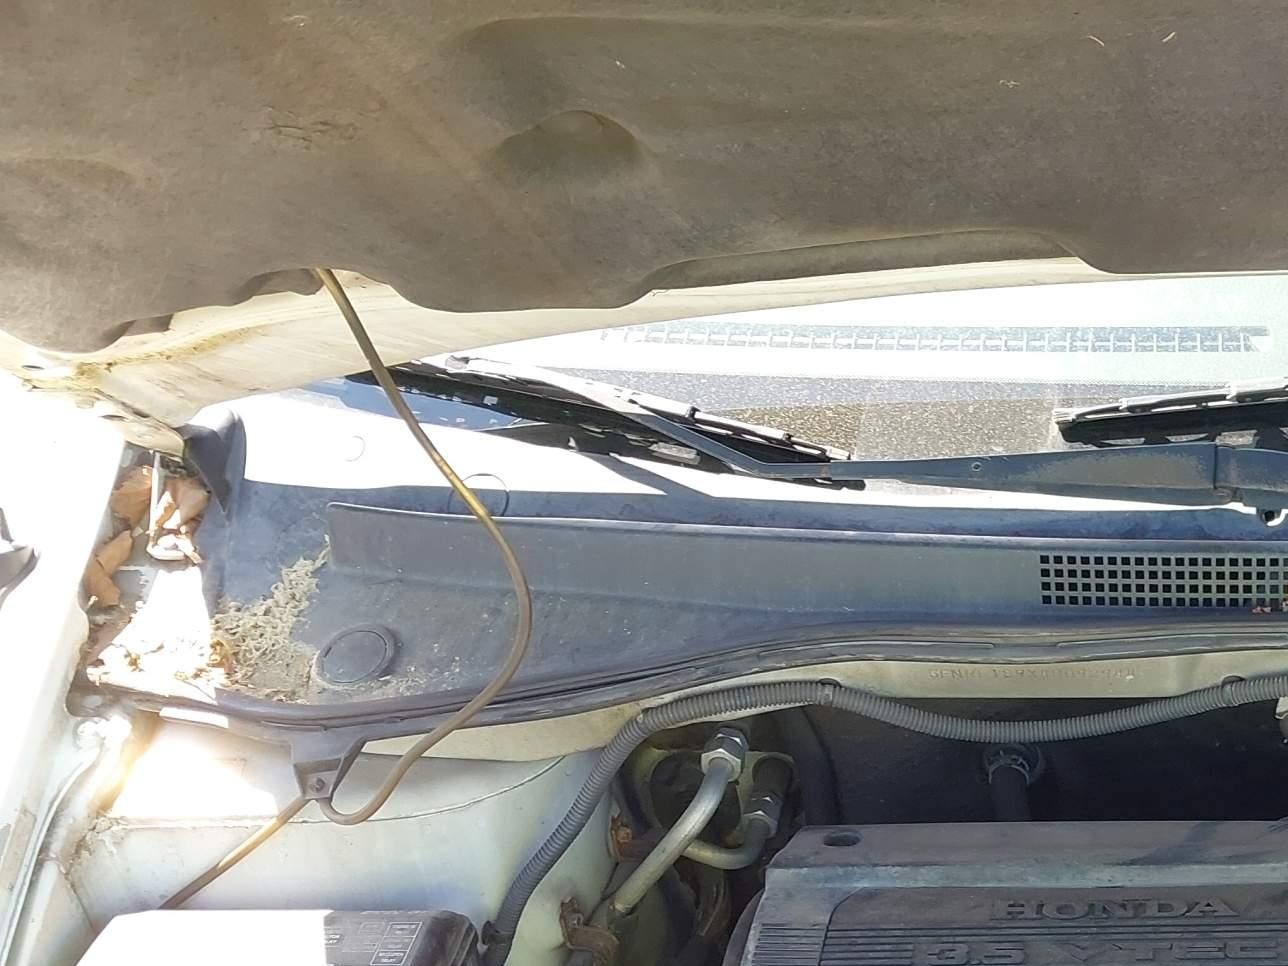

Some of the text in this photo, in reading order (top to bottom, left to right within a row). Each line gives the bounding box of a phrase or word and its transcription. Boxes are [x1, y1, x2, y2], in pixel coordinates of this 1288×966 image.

[996, 897, 1239, 920] HONDA
[926, 939, 1282, 966] 3.5 VTEC
